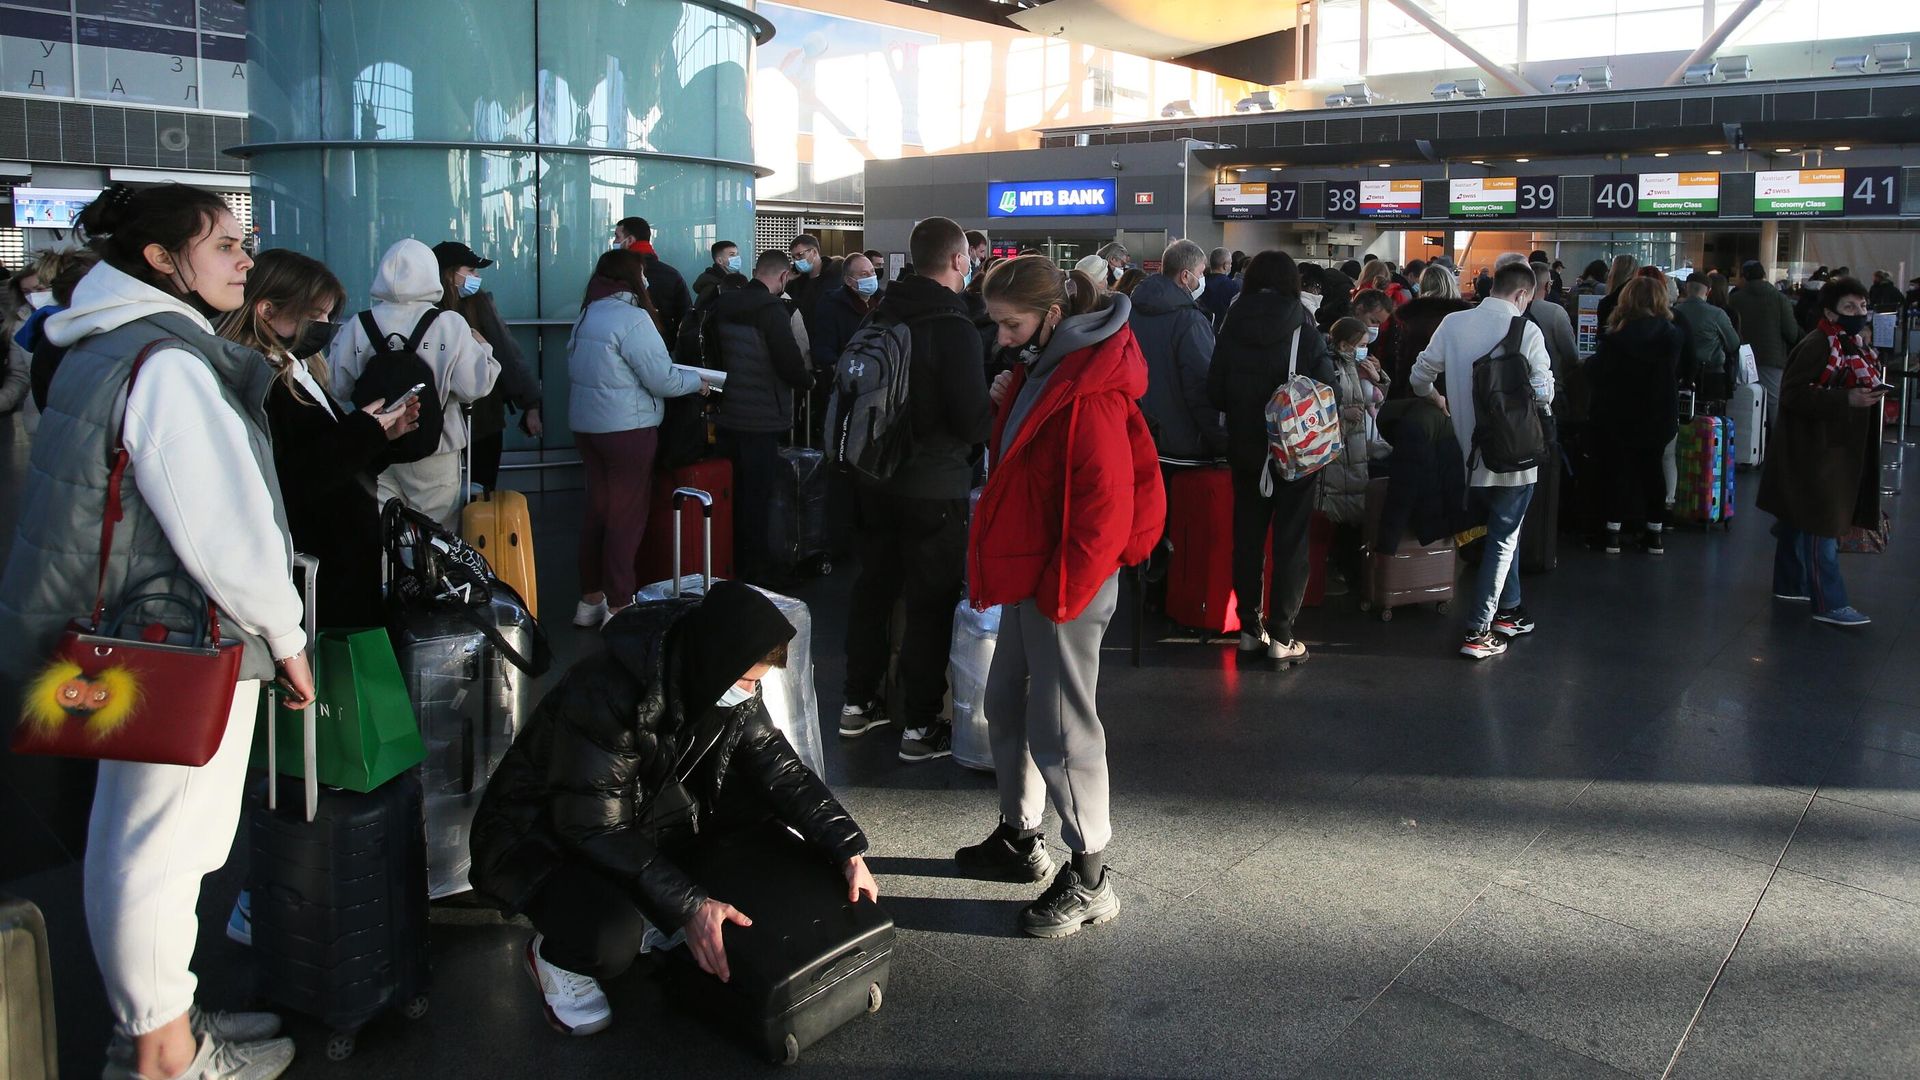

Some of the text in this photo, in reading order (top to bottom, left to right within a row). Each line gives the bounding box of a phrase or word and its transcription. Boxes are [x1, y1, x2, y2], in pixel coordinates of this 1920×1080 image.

[1020, 189, 1105, 206] MTB BANK
[1270, 190, 1296, 212] 37
[1328, 188, 1356, 211] 38
[1521, 184, 1554, 209] 39
[1597, 183, 1634, 208] 40
[1853, 176, 1894, 205] 41
[1771, 201, 1805, 209] Economy
